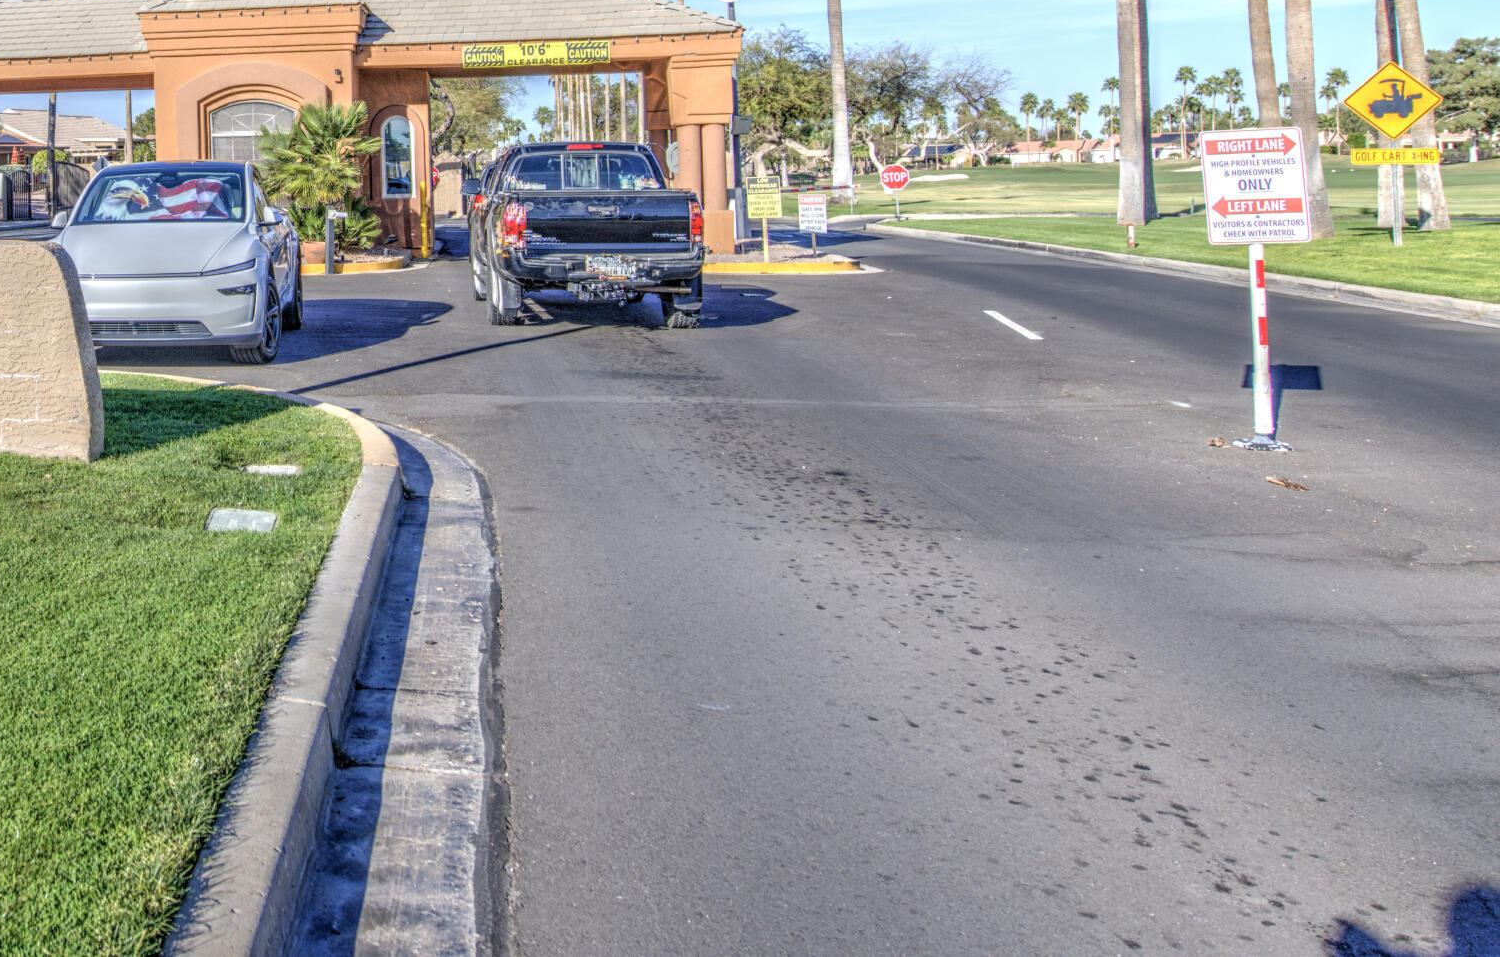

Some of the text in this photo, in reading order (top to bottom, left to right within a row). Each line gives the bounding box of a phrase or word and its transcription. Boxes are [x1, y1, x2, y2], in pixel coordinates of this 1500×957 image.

[520, 45, 551, 56] 10'6"
[568, 48, 607, 59] CAUTION
[465, 52, 503, 63] CAUTION
[507, 58, 565, 66] CLEARANCE
[1217, 139, 1284, 152] RIGHT LANE
[1355, 152, 1377, 161] GOLF
[1382, 152, 1406, 161] CART
[1262, 158, 1296, 166] VEHICLES
[883, 172, 907, 182] STOP
[1232, 168, 1284, 176] HOMEOWNERS
[1238, 178, 1272, 191] ONLY
[1227, 200, 1286, 213] LEFT LANE
[1254, 219, 1305, 227] CONTRACTORS
[1224, 230, 1246, 238] CHECK
